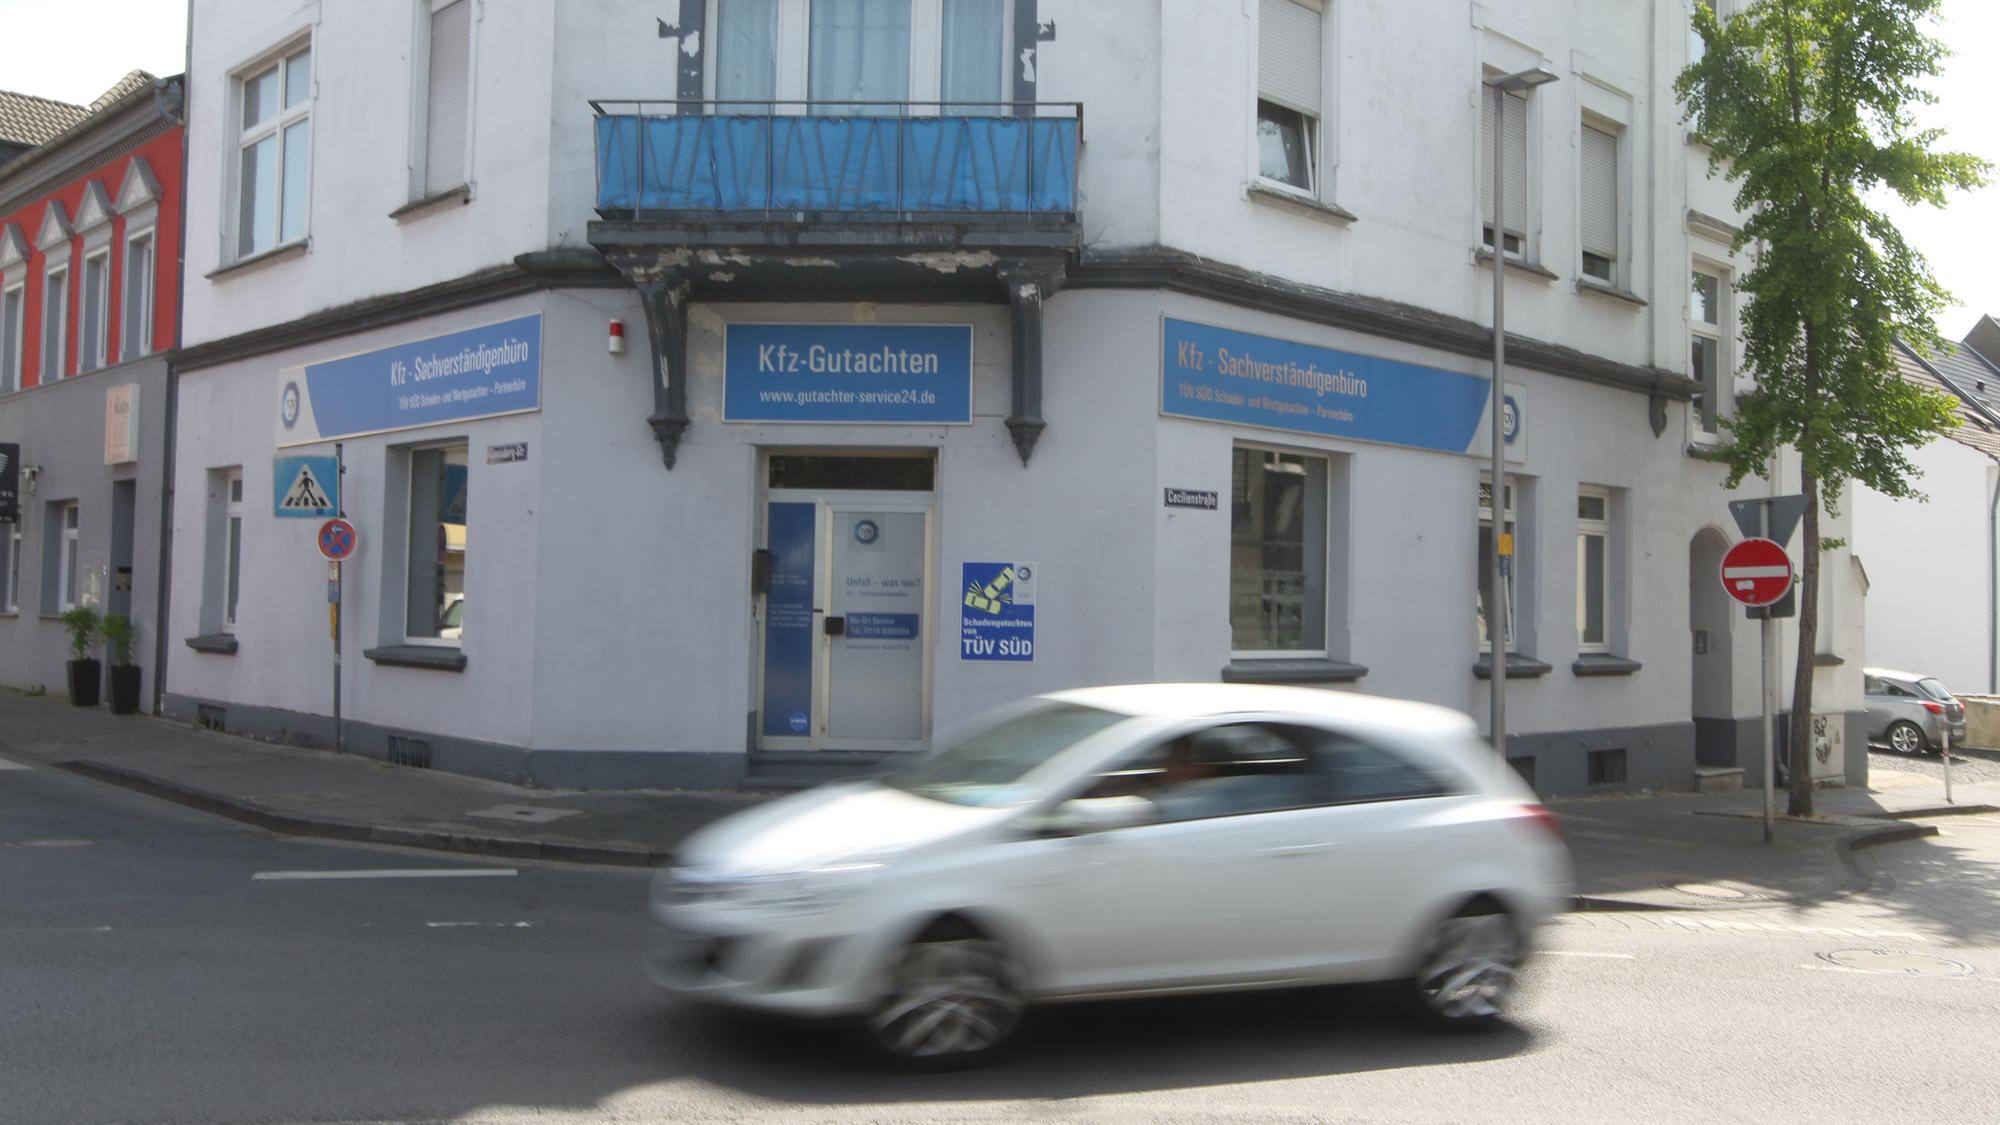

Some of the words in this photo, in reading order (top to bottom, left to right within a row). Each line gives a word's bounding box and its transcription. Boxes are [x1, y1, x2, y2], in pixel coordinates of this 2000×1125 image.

[391, 361, 406, 386] Kfz
[414, 338, 528, 382] Sachverständigenbüro
[758, 344, 938, 374] Kfz-Gutachten
[1178, 340, 1203, 371] Kfz
[1218, 348, 1367, 398] Sachverständigenbüro
[759, 388, 936, 407] www.gutachter-service24.de
[963, 617, 1033, 629] Schadengutachten
[963, 627, 978, 636] von
[963, 636, 996, 656] TÜV
[998, 636, 1033, 657] SÜD
